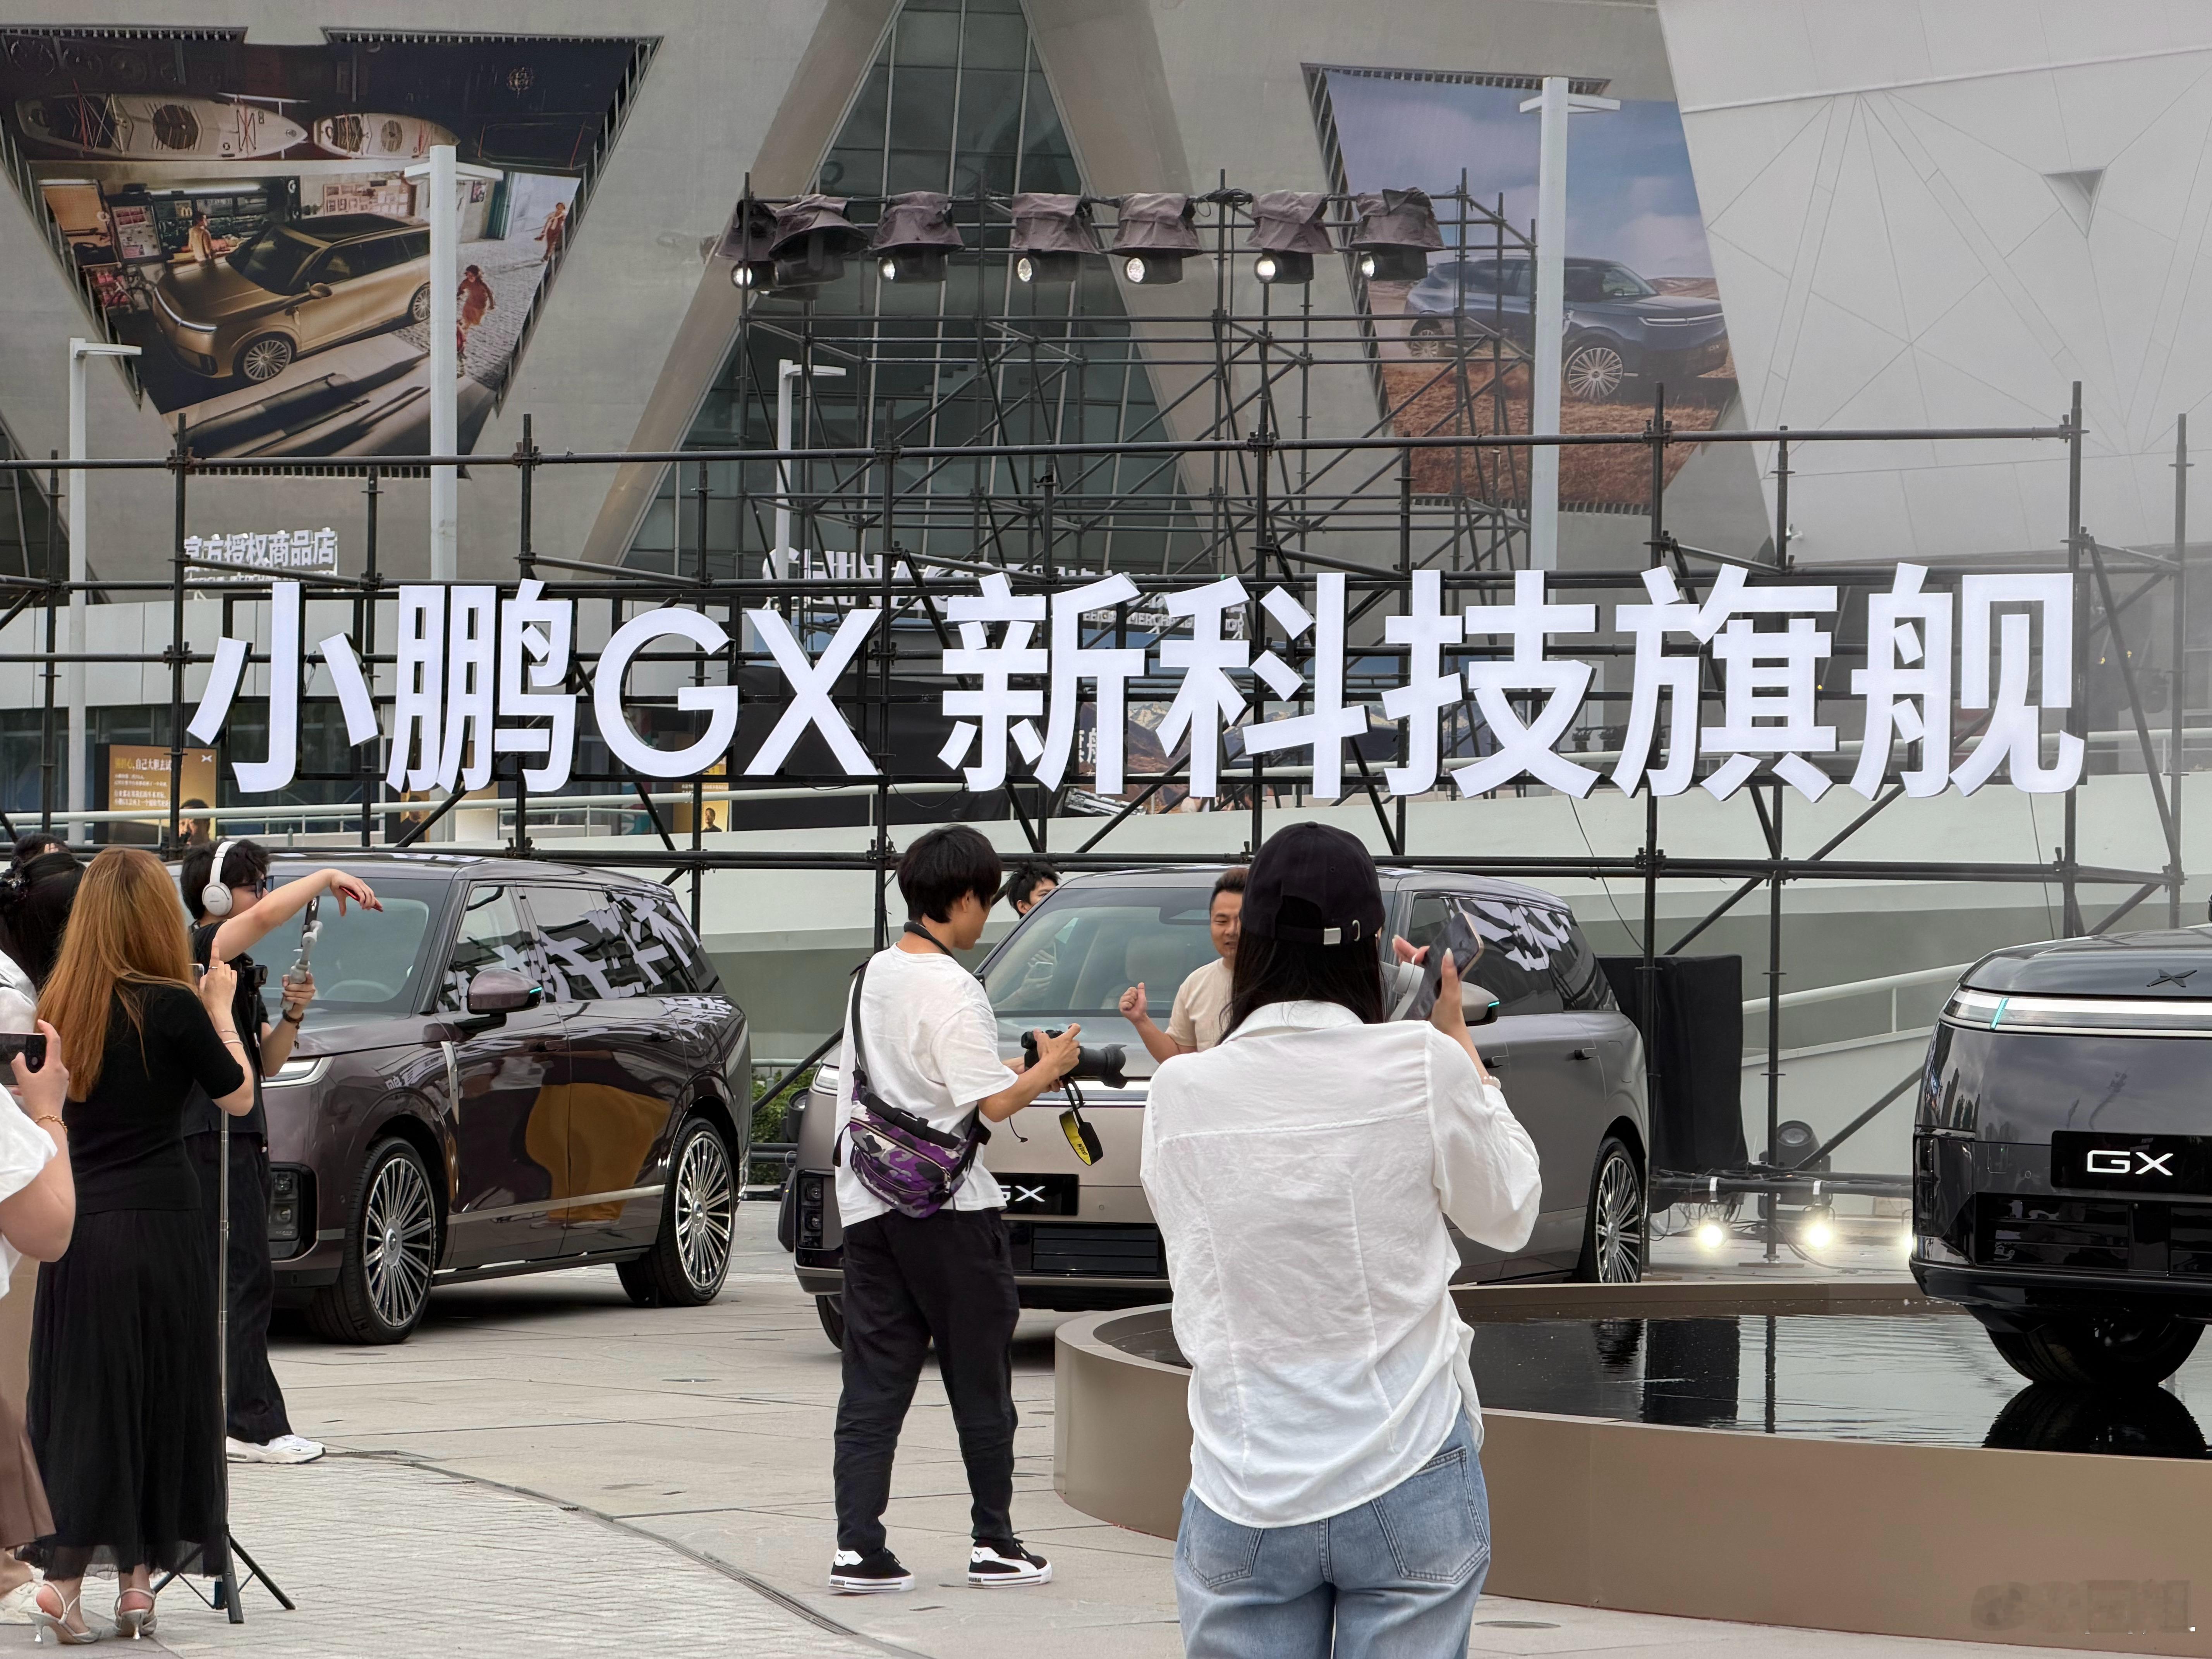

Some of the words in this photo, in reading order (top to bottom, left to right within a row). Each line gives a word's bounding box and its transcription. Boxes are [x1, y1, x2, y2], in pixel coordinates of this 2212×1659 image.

[184, 527, 335, 572] 官方授权商品店
[186, 578, 883, 793] 小鹏GX
[937, 563, 2085, 802] 新科技旗舰
[2087, 1150, 2174, 1176] GX
